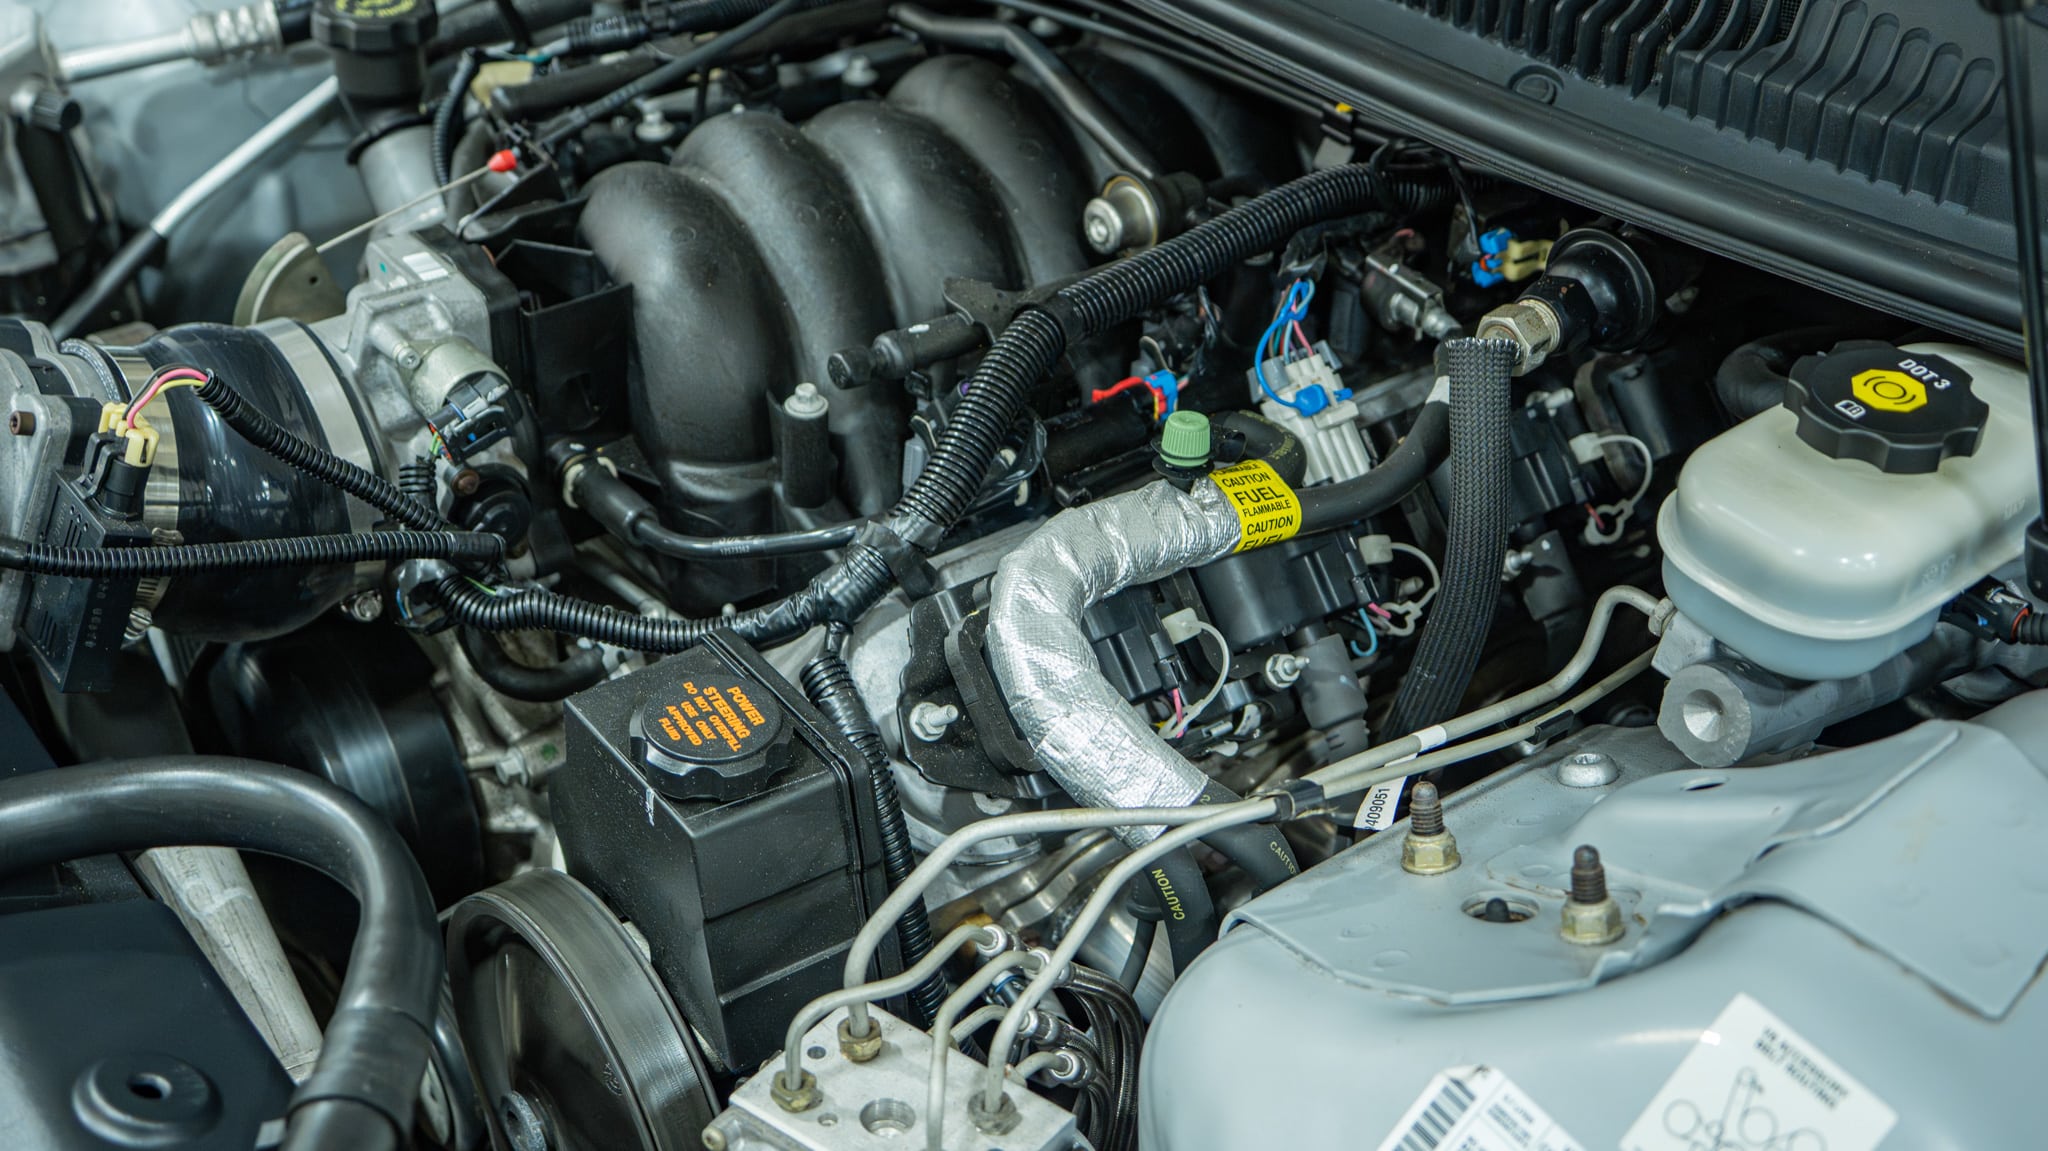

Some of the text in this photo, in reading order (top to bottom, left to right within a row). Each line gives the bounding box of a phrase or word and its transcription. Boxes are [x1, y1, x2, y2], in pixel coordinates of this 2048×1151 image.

[1898, 358, 1951, 390] DOT 3
[1222, 472, 1271, 488] CAUTION
[1233, 486, 1285, 506] FUEL
[1242, 500, 1292, 517] FLAMMABLE
[1247, 515, 1293, 536] CAUTION
[680, 701, 717, 740] USE ONLY
[682, 681, 742, 752] DO NOT OVERFILL
[703, 686, 751, 739] STEERING
[727, 686, 765, 726] POWER
[658, 717, 681, 741] FLUID
[665, 705, 703, 746] APPROVED
[1152, 868, 1186, 921] CAUTION
